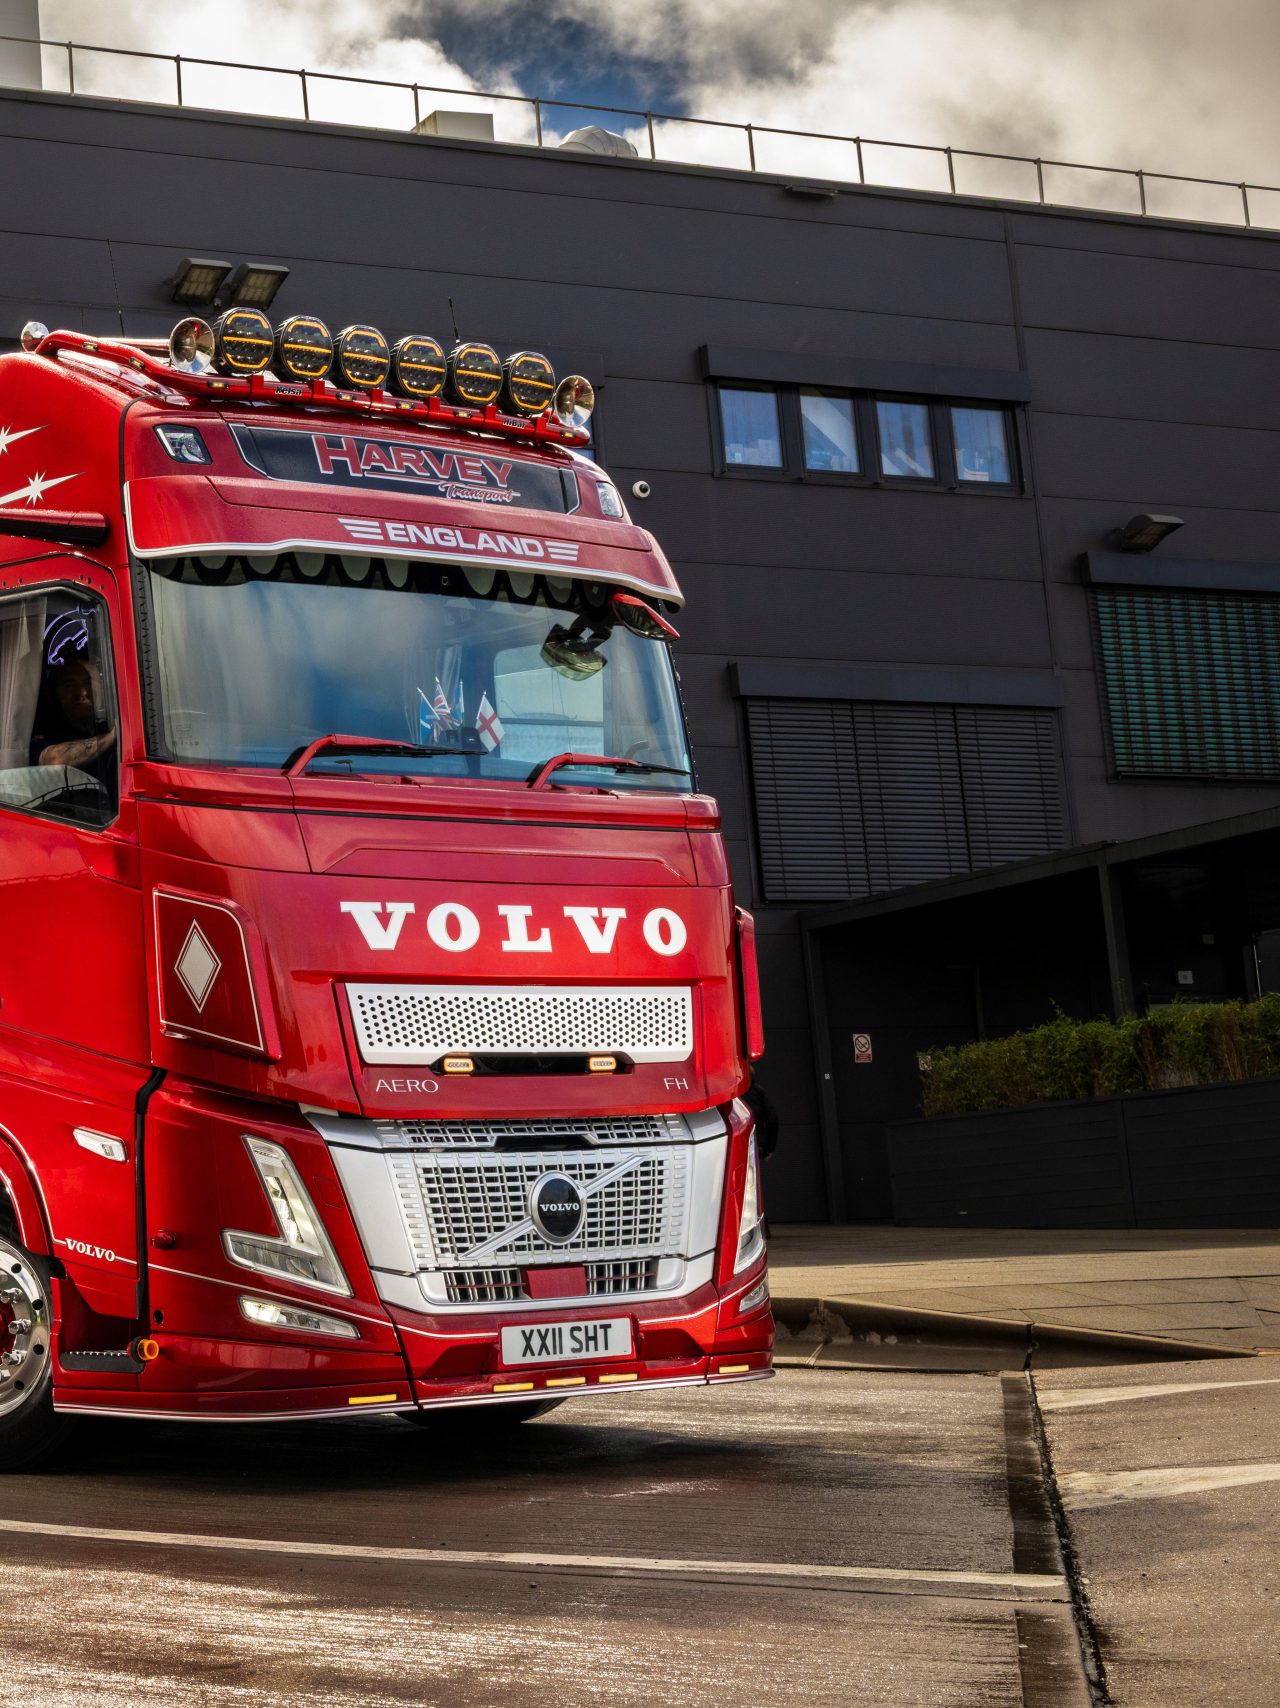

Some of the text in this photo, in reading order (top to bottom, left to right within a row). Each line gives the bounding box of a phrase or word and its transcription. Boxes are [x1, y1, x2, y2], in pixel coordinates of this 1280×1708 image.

[275, 385, 303, 397] Kelsa
[311, 434, 513, 488] HARVEY
[438, 480, 520, 503] Transport
[384, 522, 545, 557] ENGLAND
[340, 901, 687, 956] VOLVO
[375, 1077, 689, 1093] AERO FH
[539, 1202, 580, 1213] VOLVO
[65, 1238, 116, 1262] VOLVO
[569, 1323, 612, 1353] SHT
